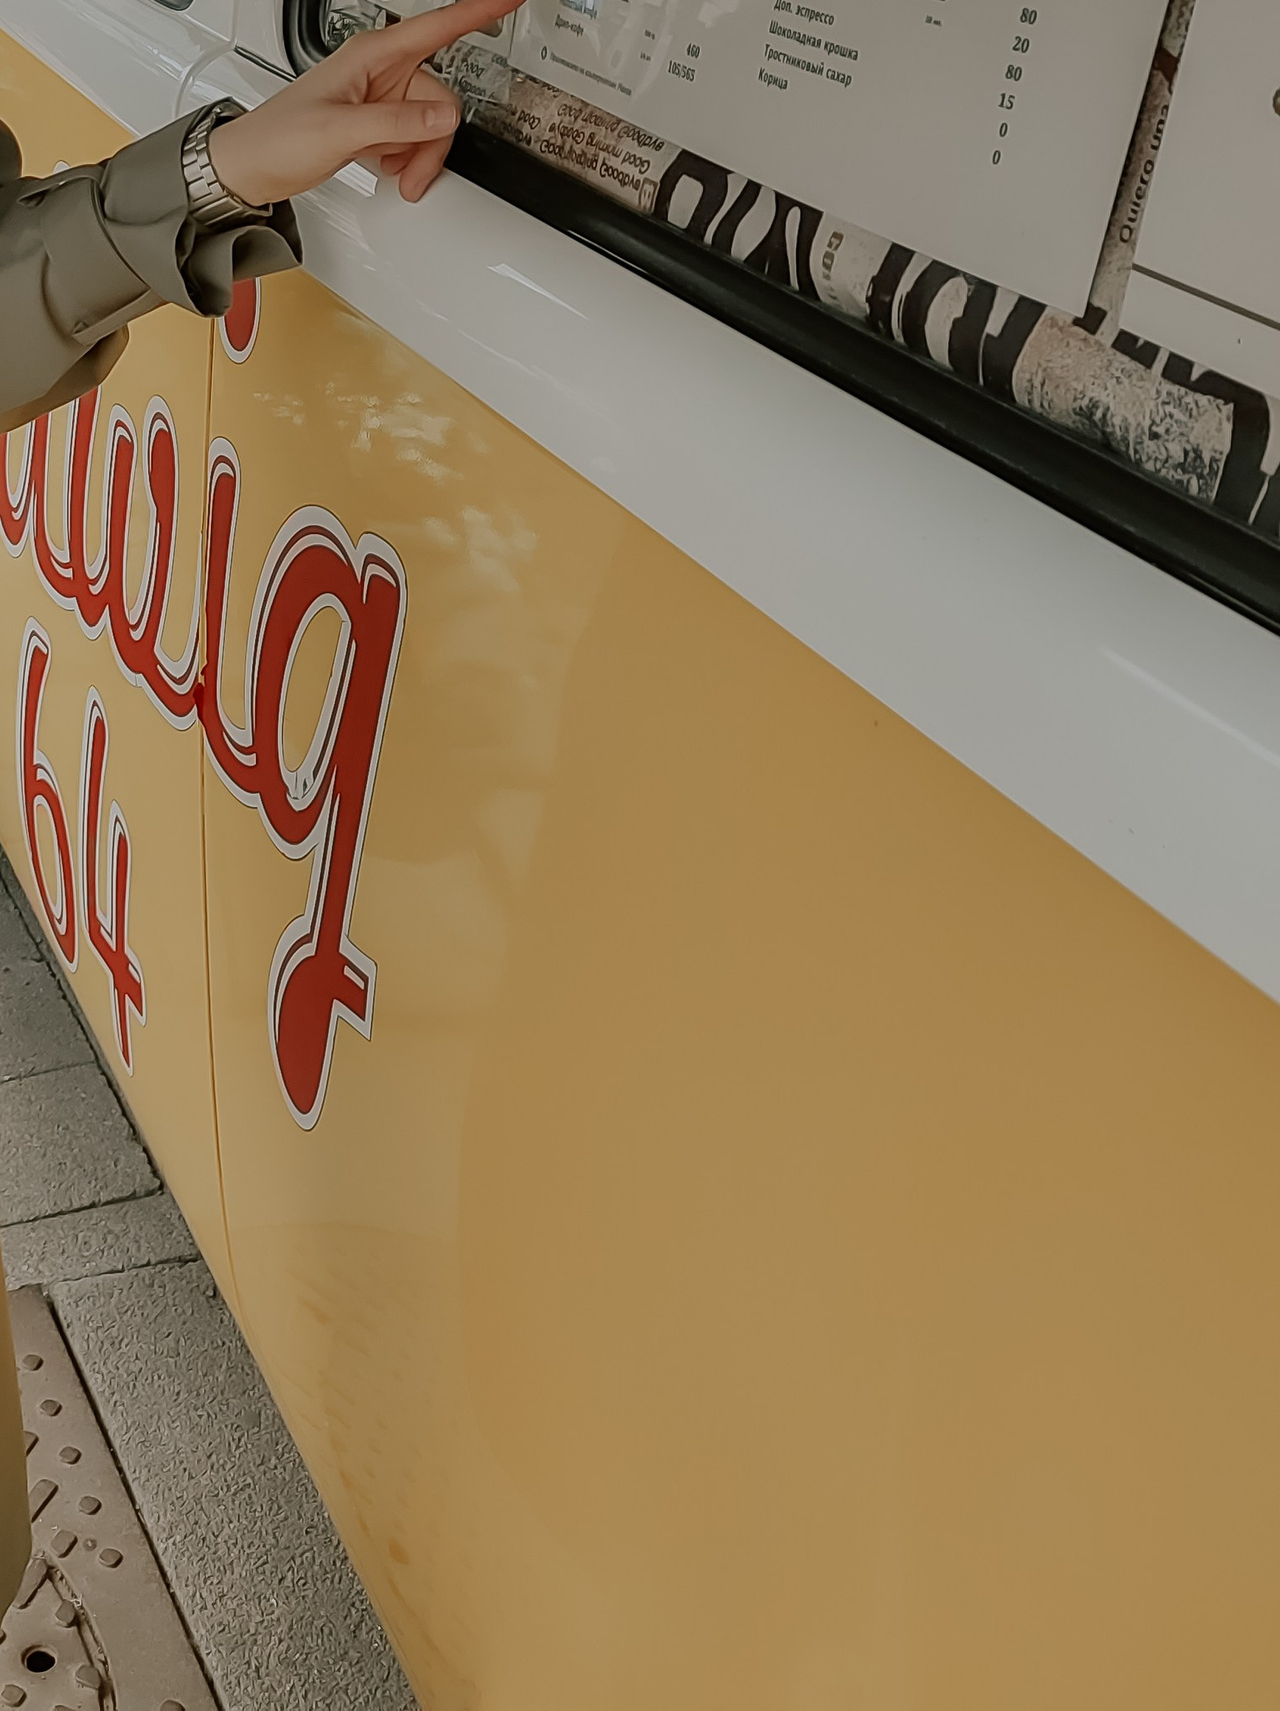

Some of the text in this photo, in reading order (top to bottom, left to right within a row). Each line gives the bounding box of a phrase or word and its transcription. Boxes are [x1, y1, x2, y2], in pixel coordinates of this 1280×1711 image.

[795, 3, 835, 26] эспрессо
[1005, 64, 1023, 82] 80
[1012, 36, 1030, 53] 20
[1020, 7, 1038, 25] 80
[764, 44, 1008, 138] Тростниковый сахар 0
[769, 20, 1016, 110] Шоколадная крошка 15
[758, 67, 1001, 166] Корица 0
[16, 616, 146, 1076] 64
